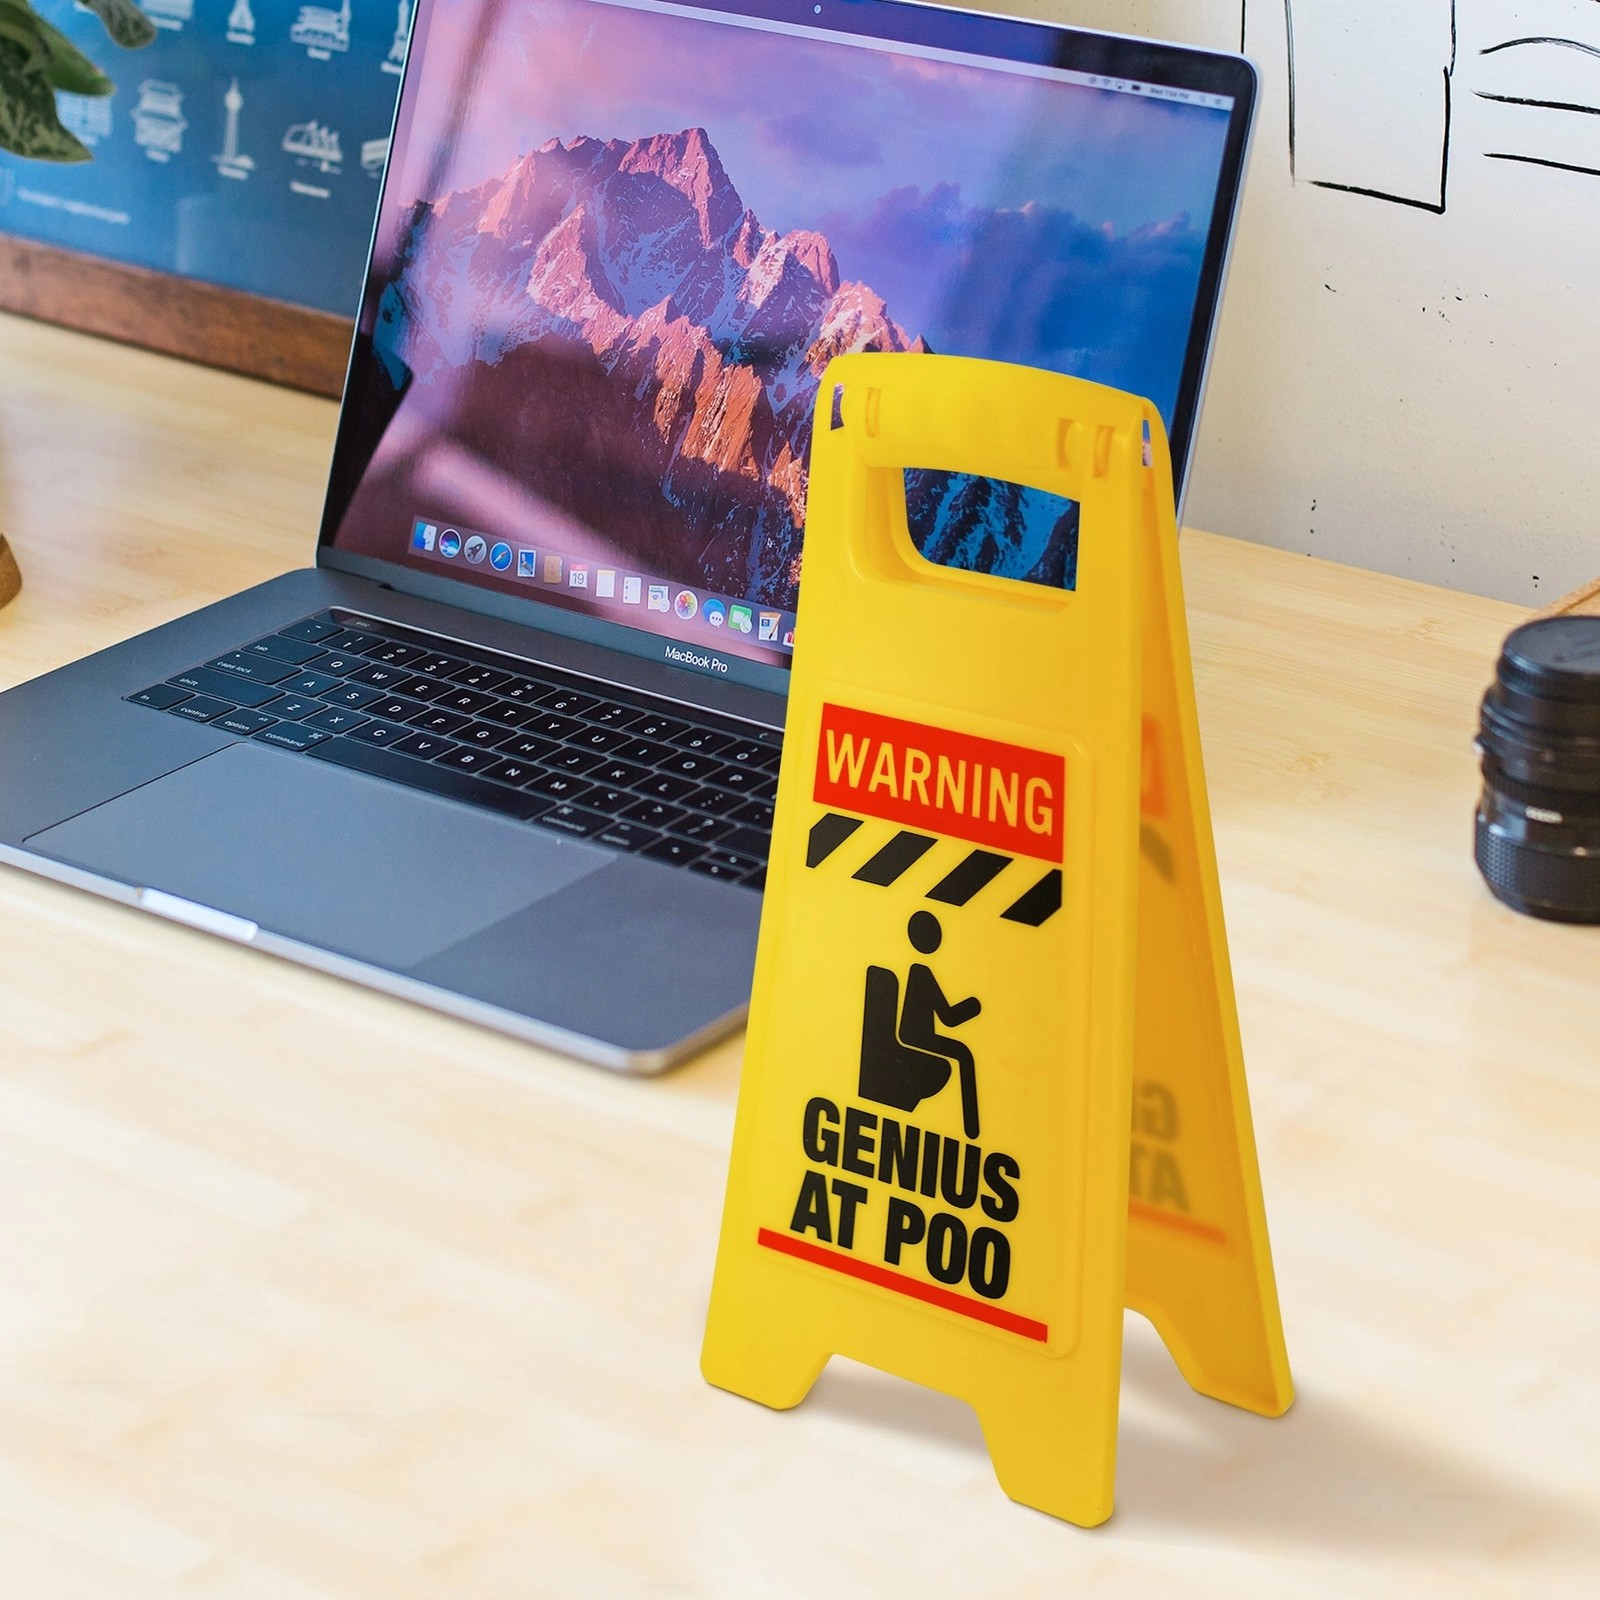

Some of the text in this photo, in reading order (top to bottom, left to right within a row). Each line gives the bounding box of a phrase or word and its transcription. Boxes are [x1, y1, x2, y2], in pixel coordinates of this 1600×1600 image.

[572, 573, 585, 585] 19
[665, 645, 728, 673] MacBook Pro
[217, 661, 252, 674] caps lock
[371, 672, 389, 681] W
[178, 677, 200, 687] shift
[302, 680, 316, 688] A
[414, 684, 429, 692] E
[346, 692, 360, 700] S
[510, 689, 524, 697] 5
[457, 697, 471, 705] R
[286, 703, 301, 711] Z
[387, 704, 402, 713] D
[180, 706, 210, 719] control
[503, 709, 517, 717] T
[328, 716, 344, 724] X
[431, 717, 446, 725] F
[224, 720, 250, 732] option
[547, 722, 561, 730] Y
[373, 729, 387, 737] C
[476, 730, 490, 739] G
[265, 732, 306, 748] command
[591, 735, 606, 743] U
[689, 739, 703, 748] 9
[418, 741, 433, 750] V
[519, 743, 536, 752] H
[460, 754, 475, 763] B
[566, 757, 580, 765] J
[505, 767, 521, 777] N
[610, 769, 626, 779] K
[728, 774, 744, 782] P
[826, 729, 1053, 836] WARNING
[549, 781, 568, 791] M
[803, 1096, 1020, 1223] GENIUS
[790, 1169, 1011, 1300] AT POO
